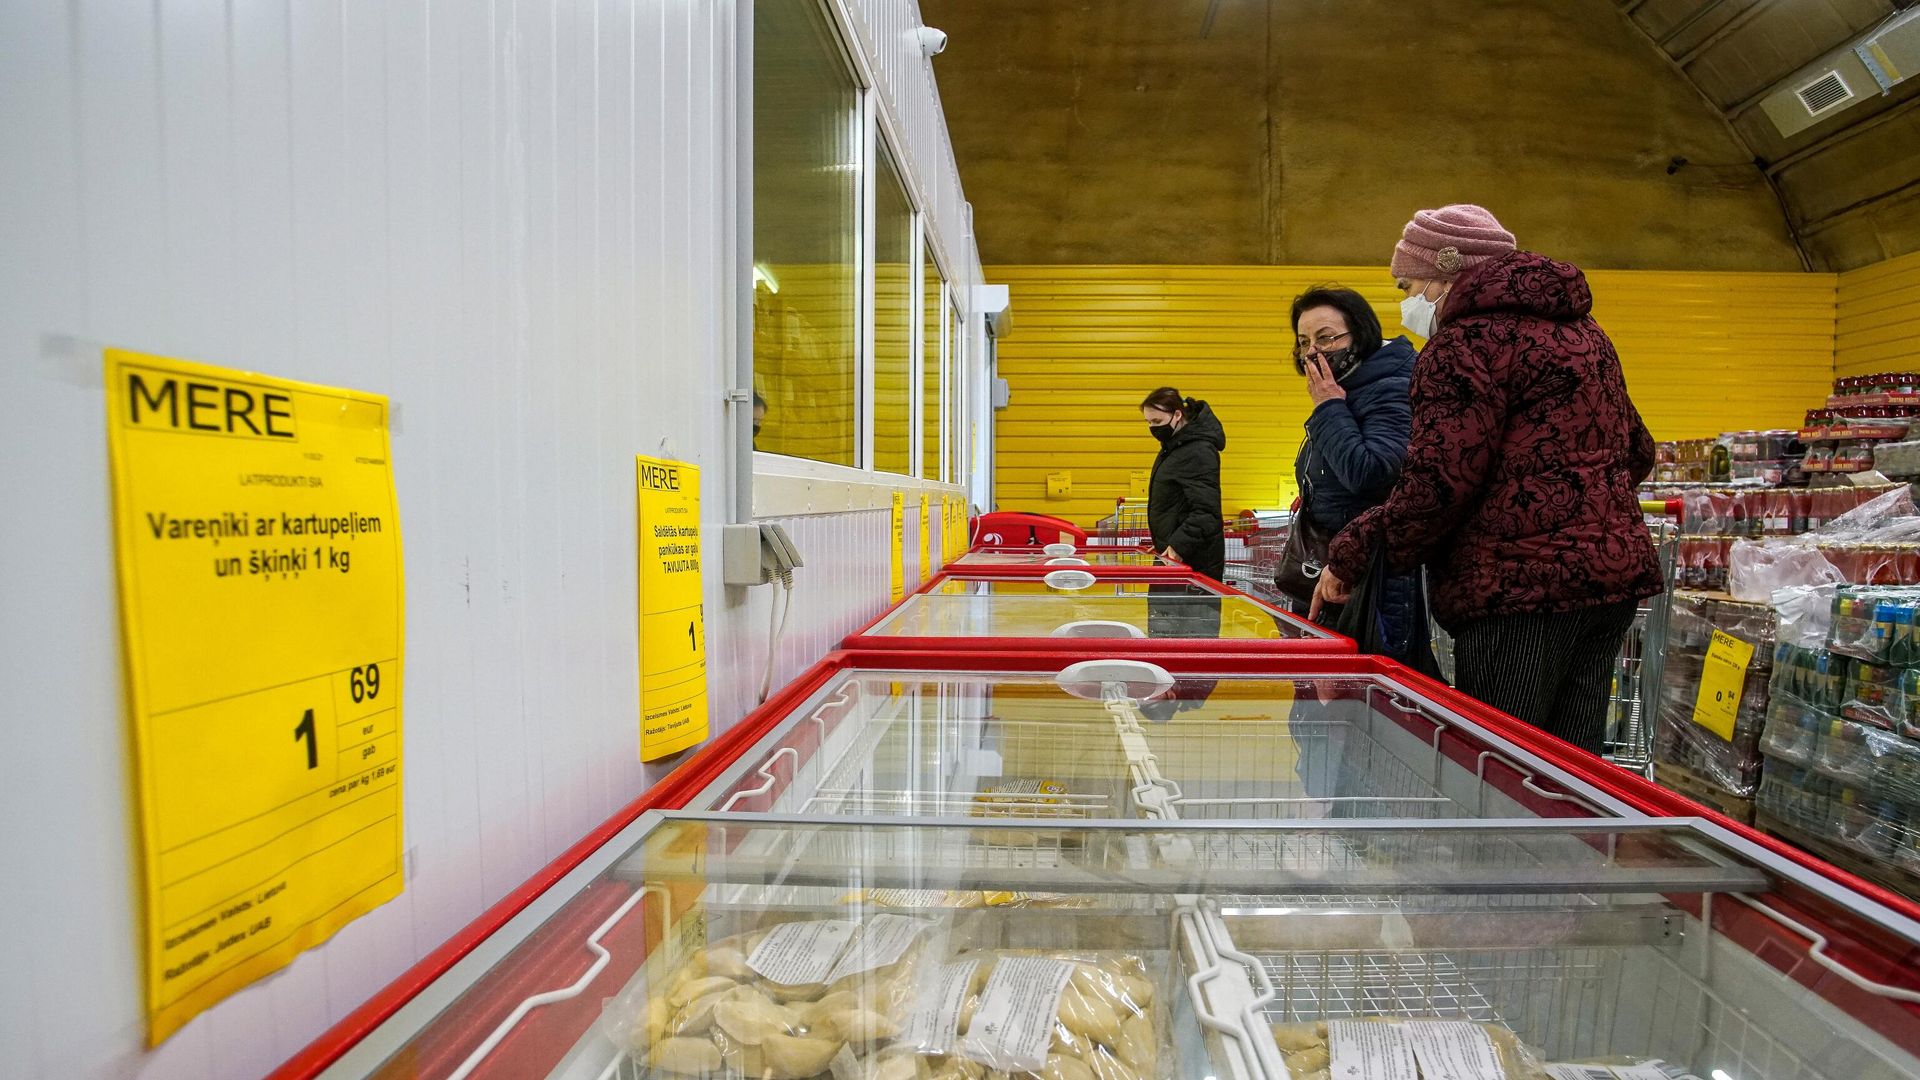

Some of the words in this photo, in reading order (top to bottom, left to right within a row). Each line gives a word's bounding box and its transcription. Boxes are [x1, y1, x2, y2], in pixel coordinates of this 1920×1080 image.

[128, 373, 294, 438] MERE
[641, 464, 679, 490] MERE
[147, 512, 249, 546] Vareņiki
[255, 517, 276, 537] ar
[282, 511, 382, 541] kartupeļiem
[216, 557, 241, 577] un
[250, 547, 307, 581] šķiņķi
[313, 548, 322, 569] 1
[329, 546, 350, 573] kg
[688, 621, 696, 651] 1
[1713, 632, 1735, 649] MERE
[1716, 691, 1722, 702] 0
[294, 708, 318, 770] 1
[350, 663, 380, 704] 69
[362, 724, 374, 736] eur
[362, 744, 376, 760] gab
[361, 775, 369, 786] kg
[386, 765, 396, 775] eur
